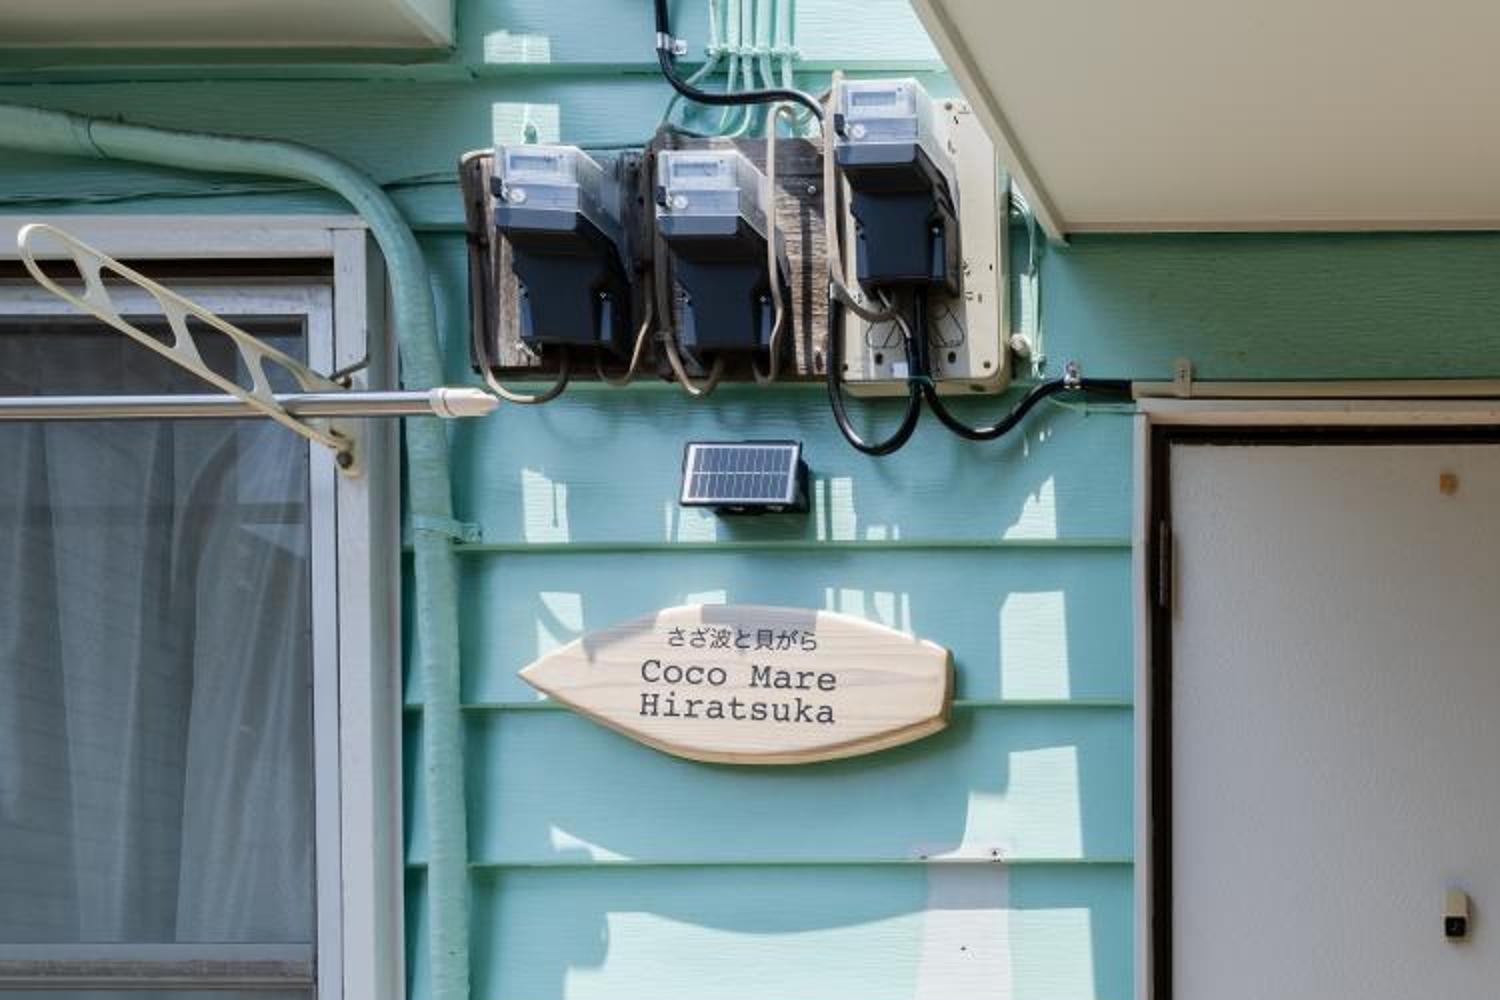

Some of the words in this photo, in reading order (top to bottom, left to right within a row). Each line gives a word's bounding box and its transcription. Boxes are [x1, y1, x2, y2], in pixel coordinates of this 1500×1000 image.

[667, 626, 818, 651] さざ波と貝がら
[641, 659, 727, 686] Coco
[749, 665, 837, 691] Mare
[639, 691, 835, 724] Hiratsuka
